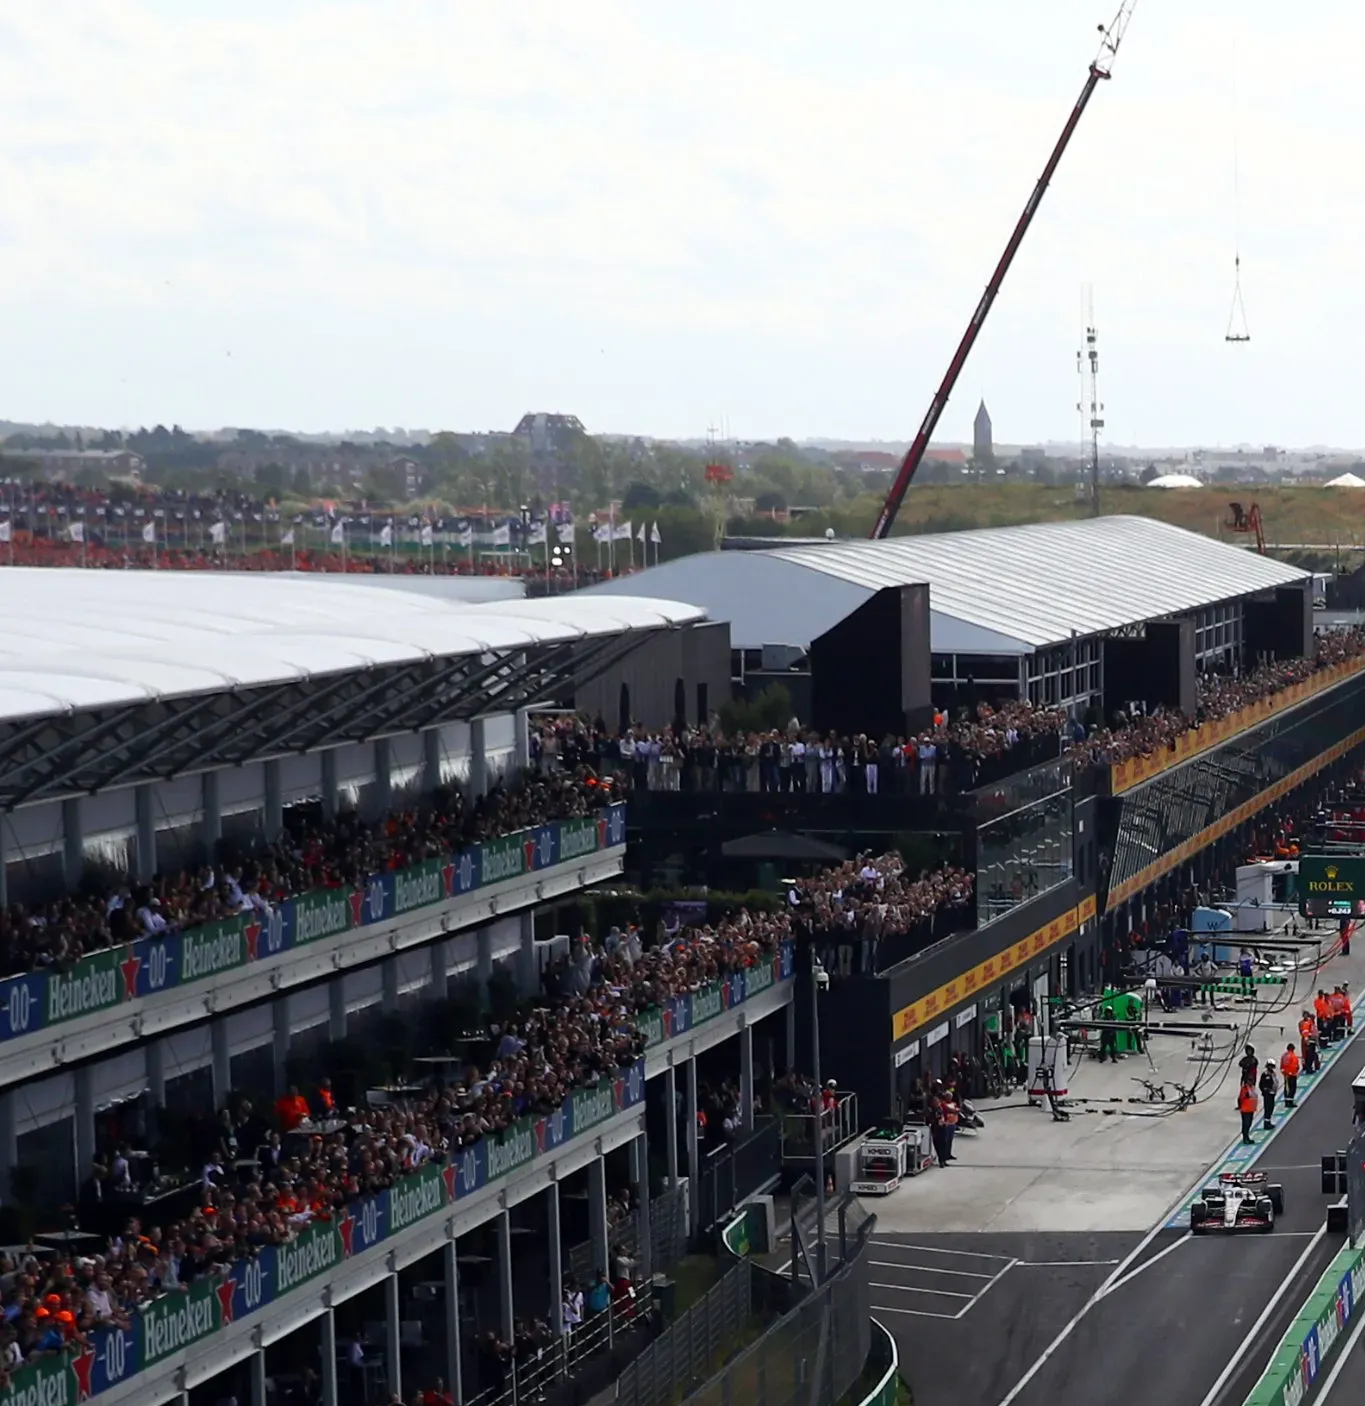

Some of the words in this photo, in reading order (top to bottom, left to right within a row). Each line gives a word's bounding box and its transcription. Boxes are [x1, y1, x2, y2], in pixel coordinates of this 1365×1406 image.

[1309, 881, 1353, 892] ROLEX
[48, 964, 117, 1020] Heineken
[182, 928, 241, 979] Heineken
[295, 895, 346, 942] Heineken
[144, 1294, 213, 1361] Heineken
[277, 1230, 336, 1291] Heineken
[389, 1175, 441, 1229] Heineken
